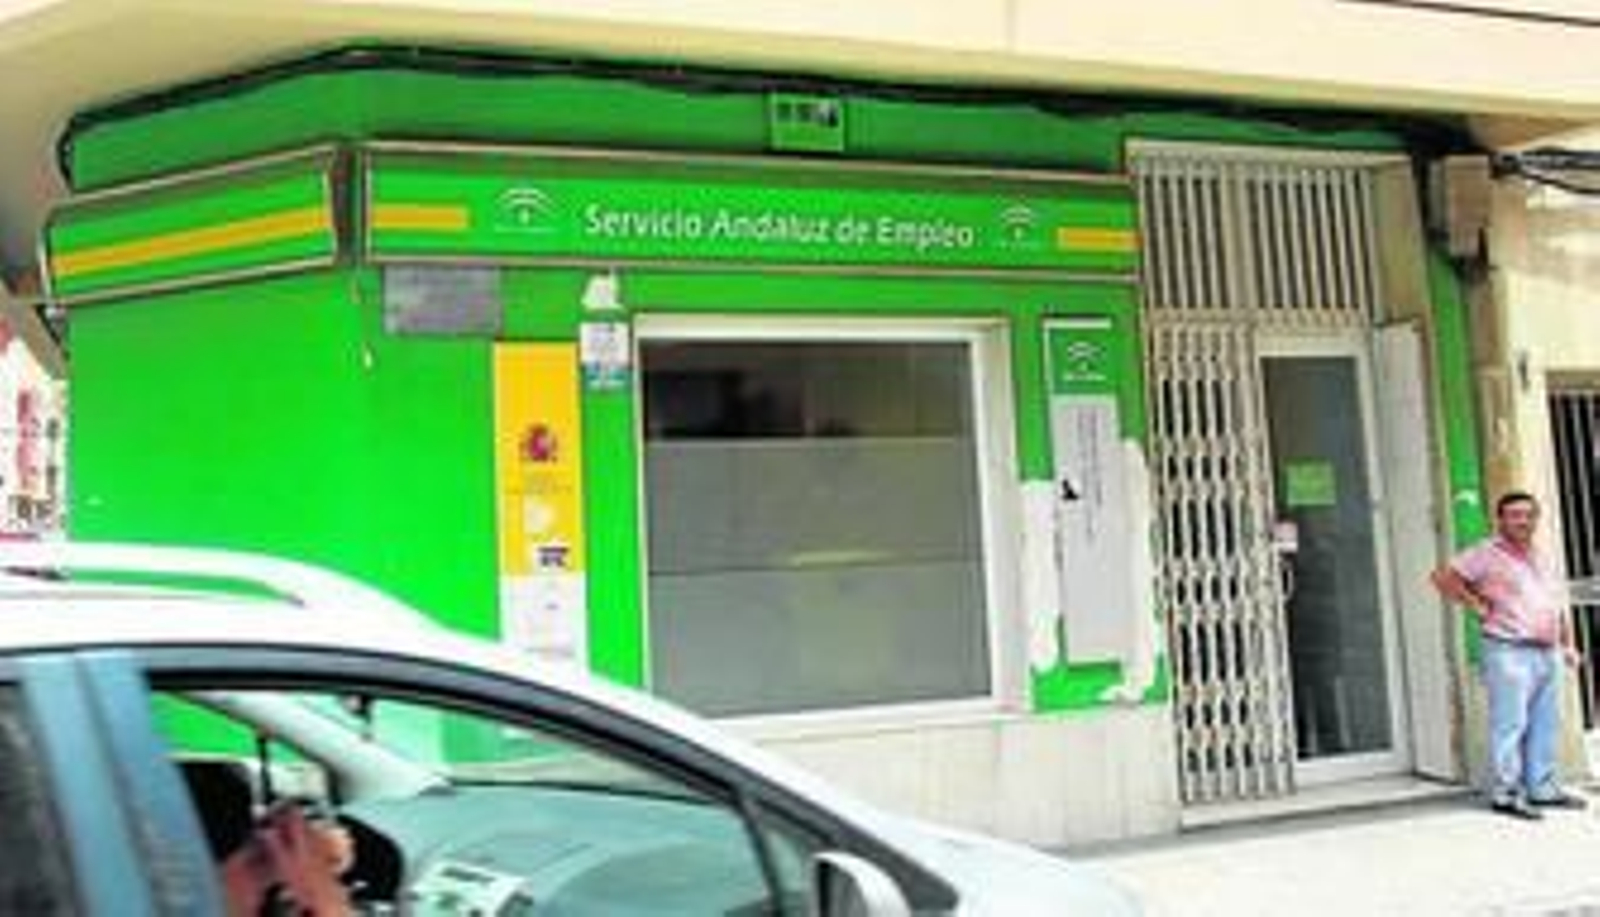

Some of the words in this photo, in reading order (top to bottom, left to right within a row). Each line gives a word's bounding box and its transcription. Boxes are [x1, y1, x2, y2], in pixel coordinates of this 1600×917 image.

[584, 203, 702, 239] Servicio
[707, 207, 831, 244] Andaluz
[835, 213, 870, 245] de
[876, 216, 974, 252] Empleo
